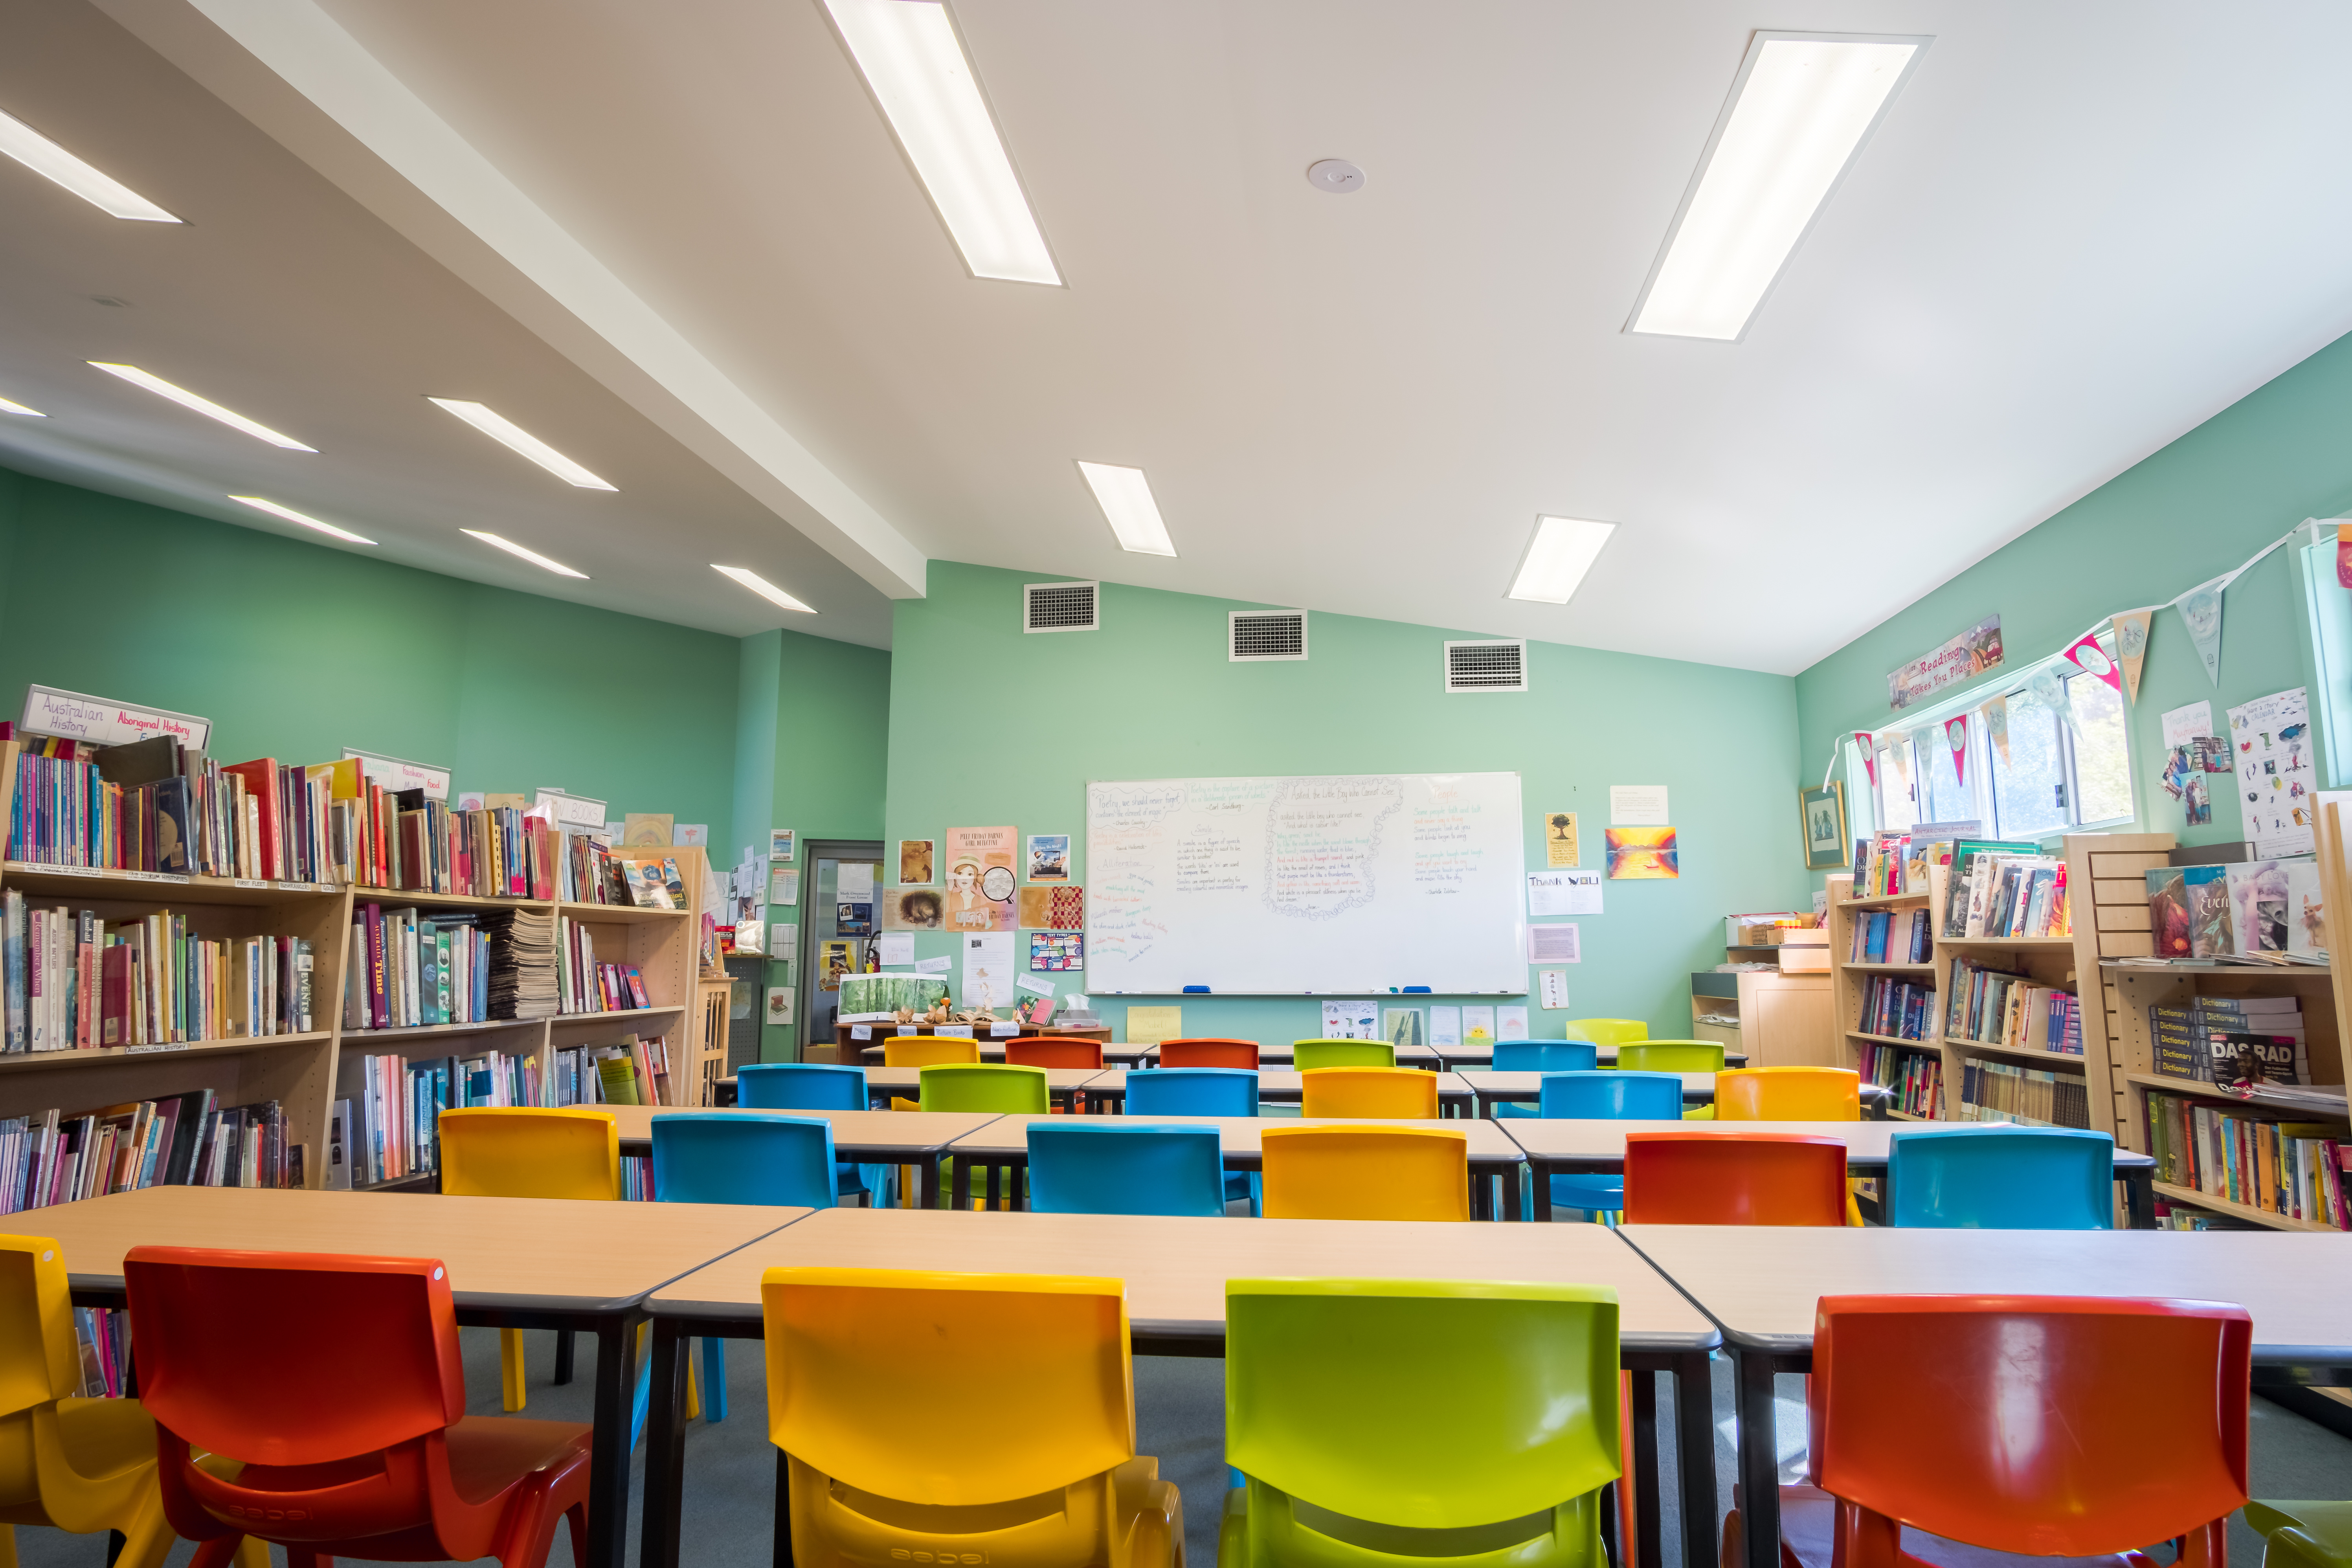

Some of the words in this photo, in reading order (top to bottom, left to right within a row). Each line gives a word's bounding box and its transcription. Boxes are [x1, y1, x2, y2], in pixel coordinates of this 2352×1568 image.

[1919, 646, 1960, 675] Reading
[1910, 681, 1932, 697] Takes
[1933, 674, 1948, 685] You
[1949, 658, 1976, 678] Places
[42, 695, 103, 721] Australian
[2167, 709, 2190, 726] Thank
[2193, 711, 2207, 722] you
[2251, 709, 2275, 721] CALENDAR
[50, 716, 87, 736] History
[117, 711, 160, 731] Aboriginal
[163, 719, 190, 740] History
[402, 764, 425, 779] Fashion
[427, 778, 441, 789] Food
[1291, 786, 1311, 800] Asked
[1323, 786, 1335, 798] Little
[1336, 786, 1348, 802] Boy
[1349, 787, 1359, 797] Who
[1361, 784, 1379, 796] Cannot
[1381, 785, 1395, 795] See
[1431, 785, 1459, 804] People
[571, 802, 602, 823] BOOKS!
[1194, 823, 1212, 833] Simile
[1915, 826, 1948, 835] ANTARCTIC
[1208, 838, 1219, 847] figure
[1226, 837, 1240, 846] speech
[1204, 846, 1214, 854] thing
[1103, 856, 1142, 868] Alliteration
[162, 874, 188, 883] HISTORIES
[2267, 872, 2288, 883] LOVE
[920, 960, 945, 969] RETURNS
[375, 960, 384, 995] Time
[1021, 977, 1048, 991] RETURNS
[301, 972, 309, 1013] EVENTS
[2202, 998, 2231, 1009] Dictionary
[2158, 1008, 2187, 1019] Dictionary
[2207, 1012, 2238, 1024] Dictionary
[2160, 1021, 2188, 1033] Dictionary
[2161, 1035, 2190, 1047] Dictionary
[2163, 1049, 2192, 1061] Dictionary
[2211, 1042, 2249, 1059] DAS
[2253, 1045, 2291, 1063] RAD
[2163, 1062, 2190, 1075] Dictionary
[229, 1505, 314, 1520] sebel
[890, 1548, 990, 1565] sebel
